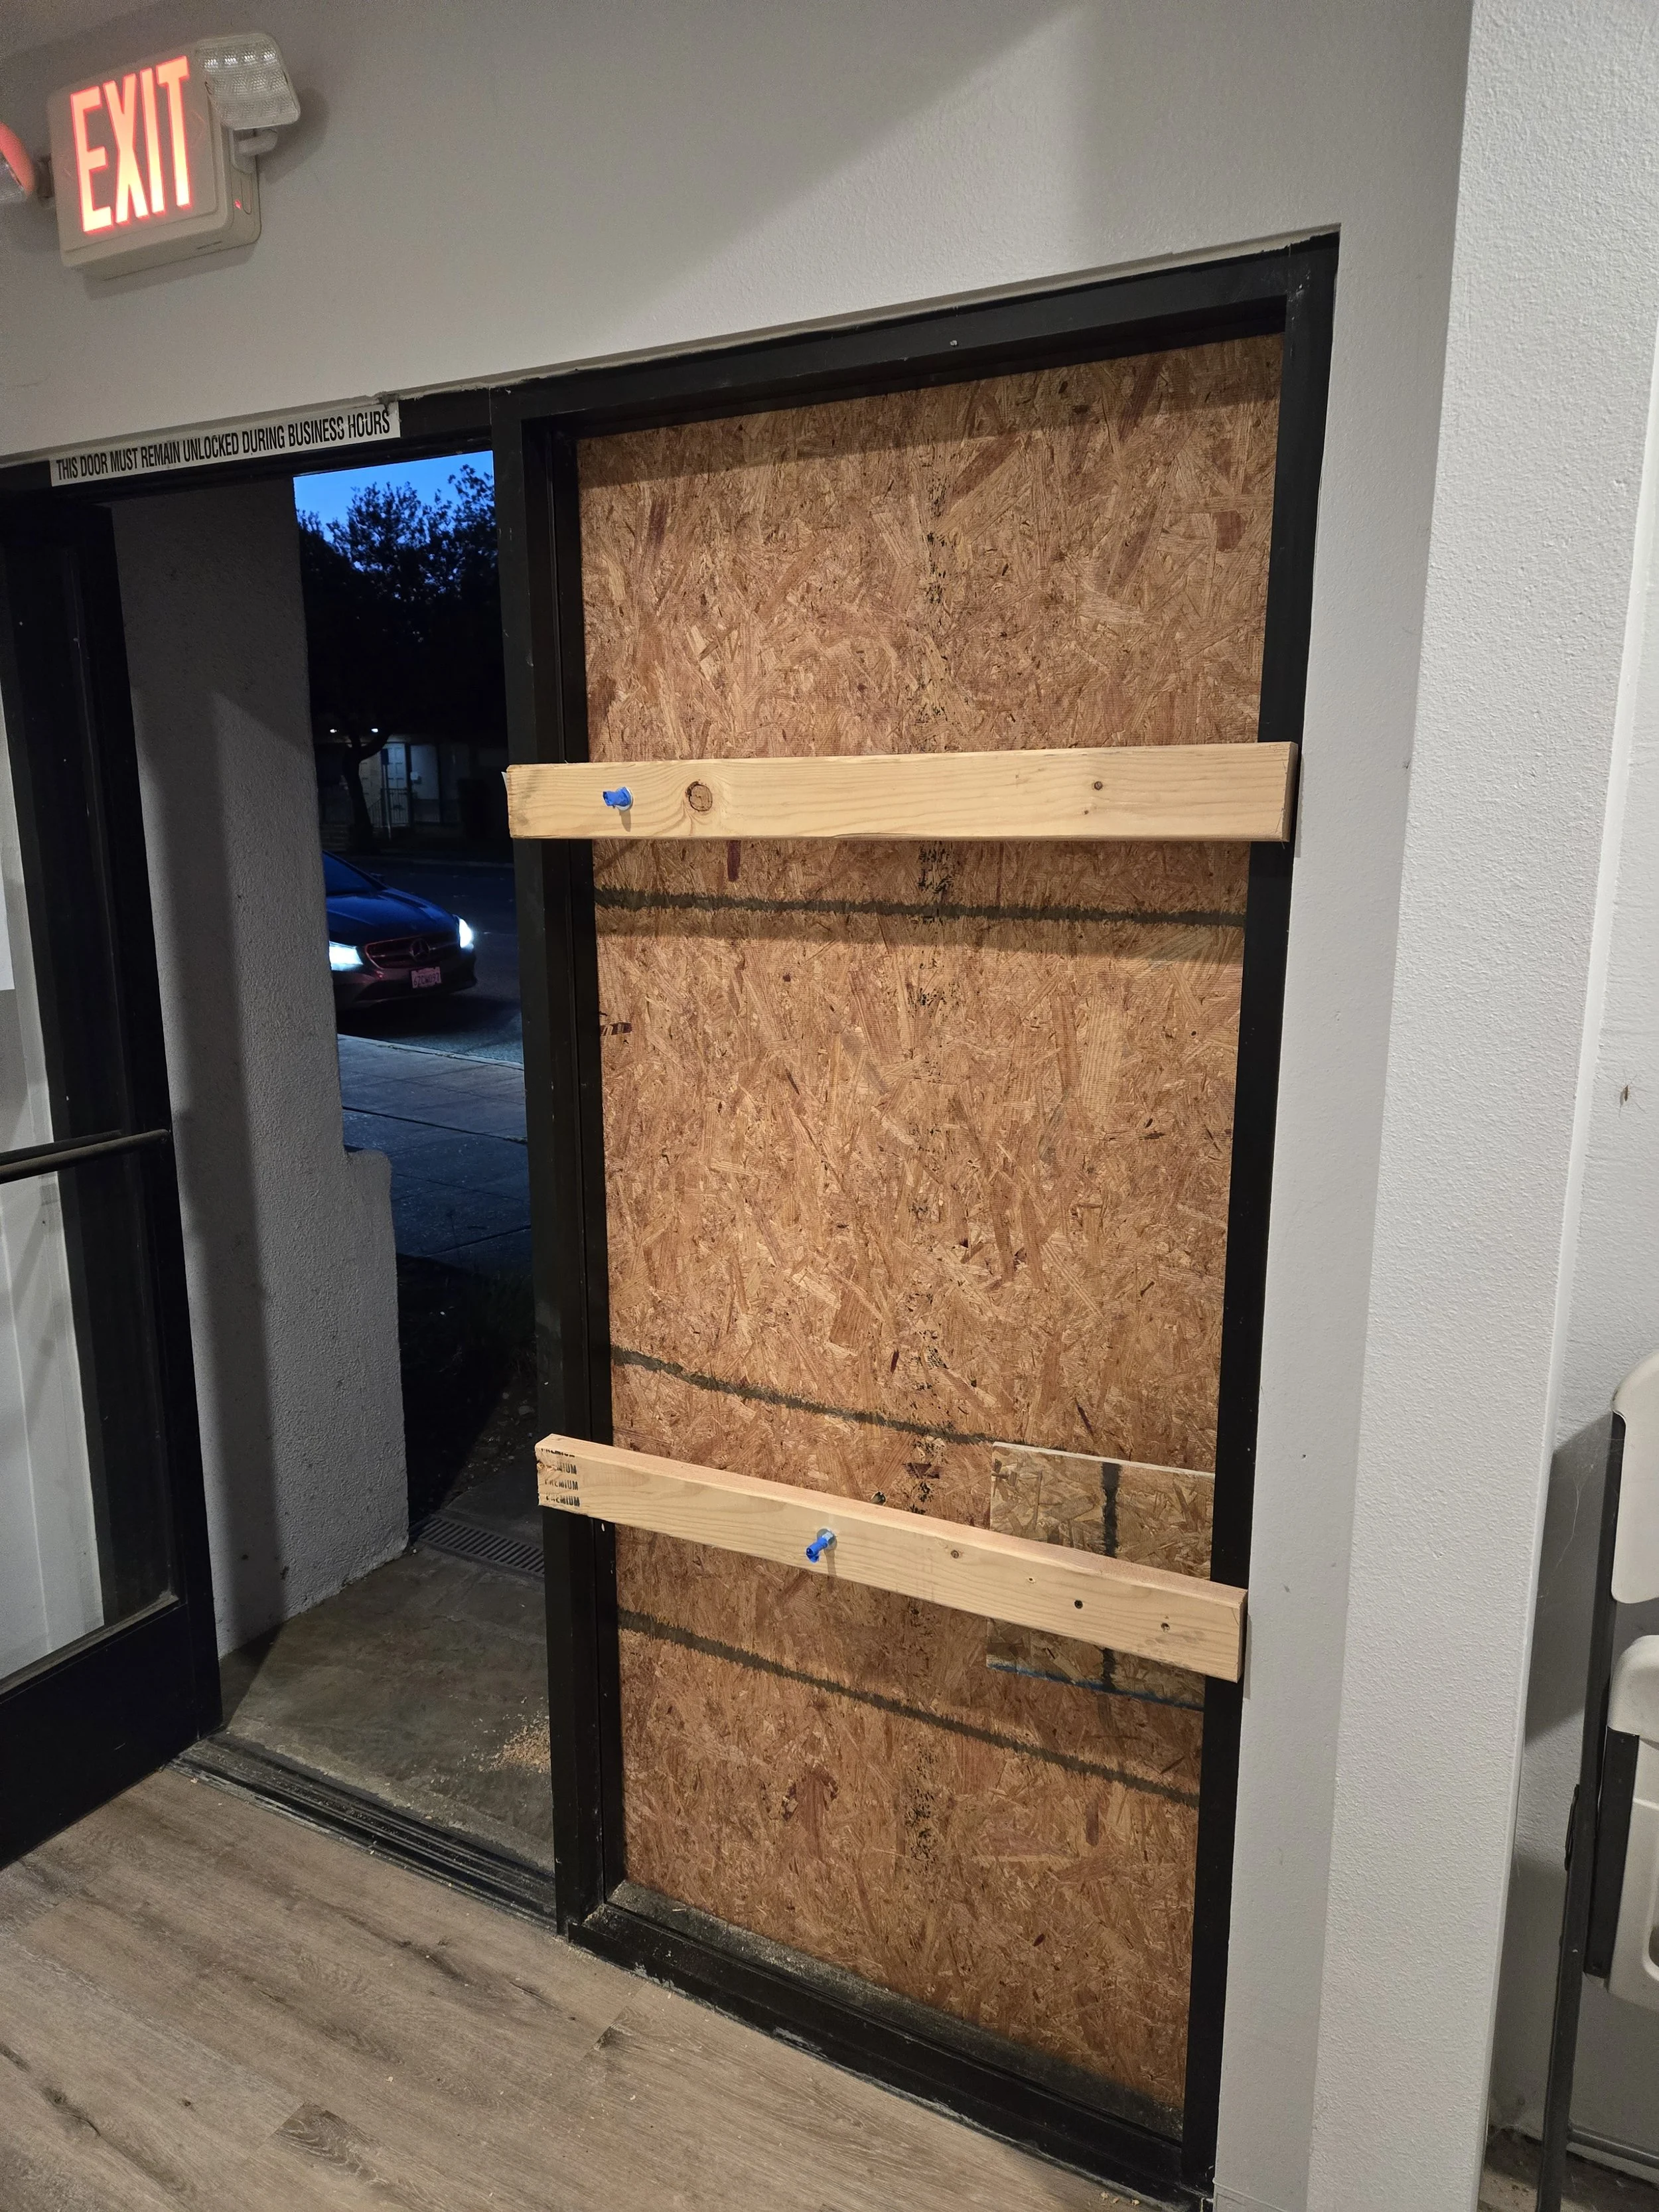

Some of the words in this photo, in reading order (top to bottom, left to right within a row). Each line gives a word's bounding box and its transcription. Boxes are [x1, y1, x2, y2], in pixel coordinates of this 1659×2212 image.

[70, 54, 191, 233] EXIT
[56, 456, 78, 480] THIS
[80, 452, 108, 477] DOOR
[110, 447, 138, 473] MUST
[141, 441, 181, 469] REMAIN
[182, 432, 239, 463] UNLOCKED
[242, 425, 285, 454] DURING
[288, 415, 345, 447] BUSINESS
[347, 409, 390, 439] HOURS
